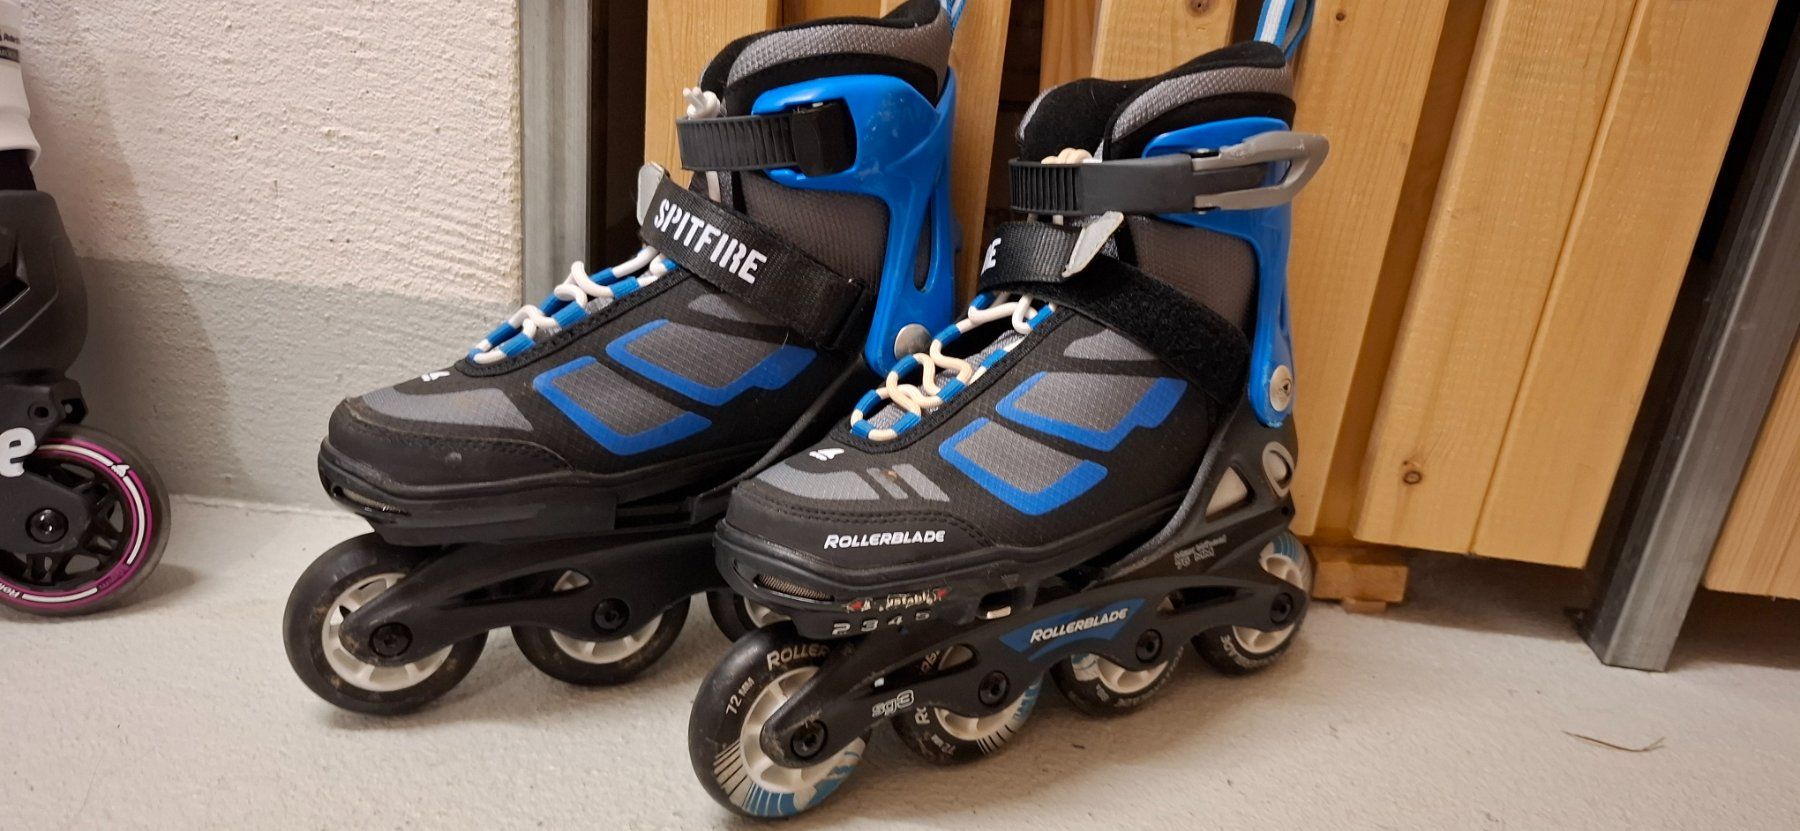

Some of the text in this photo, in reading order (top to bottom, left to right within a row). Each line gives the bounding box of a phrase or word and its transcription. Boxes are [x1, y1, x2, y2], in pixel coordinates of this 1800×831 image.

[654, 198, 768, 285] SPITFIRE
[824, 530, 946, 549] ROLLERBLADE
[832, 622, 851, 636] 2
[861, 619, 879, 633] 3
[887, 615, 903, 626] 4
[1030, 608, 1129, 644] ROLLERBLADE
[725, 694, 743, 715] 72
